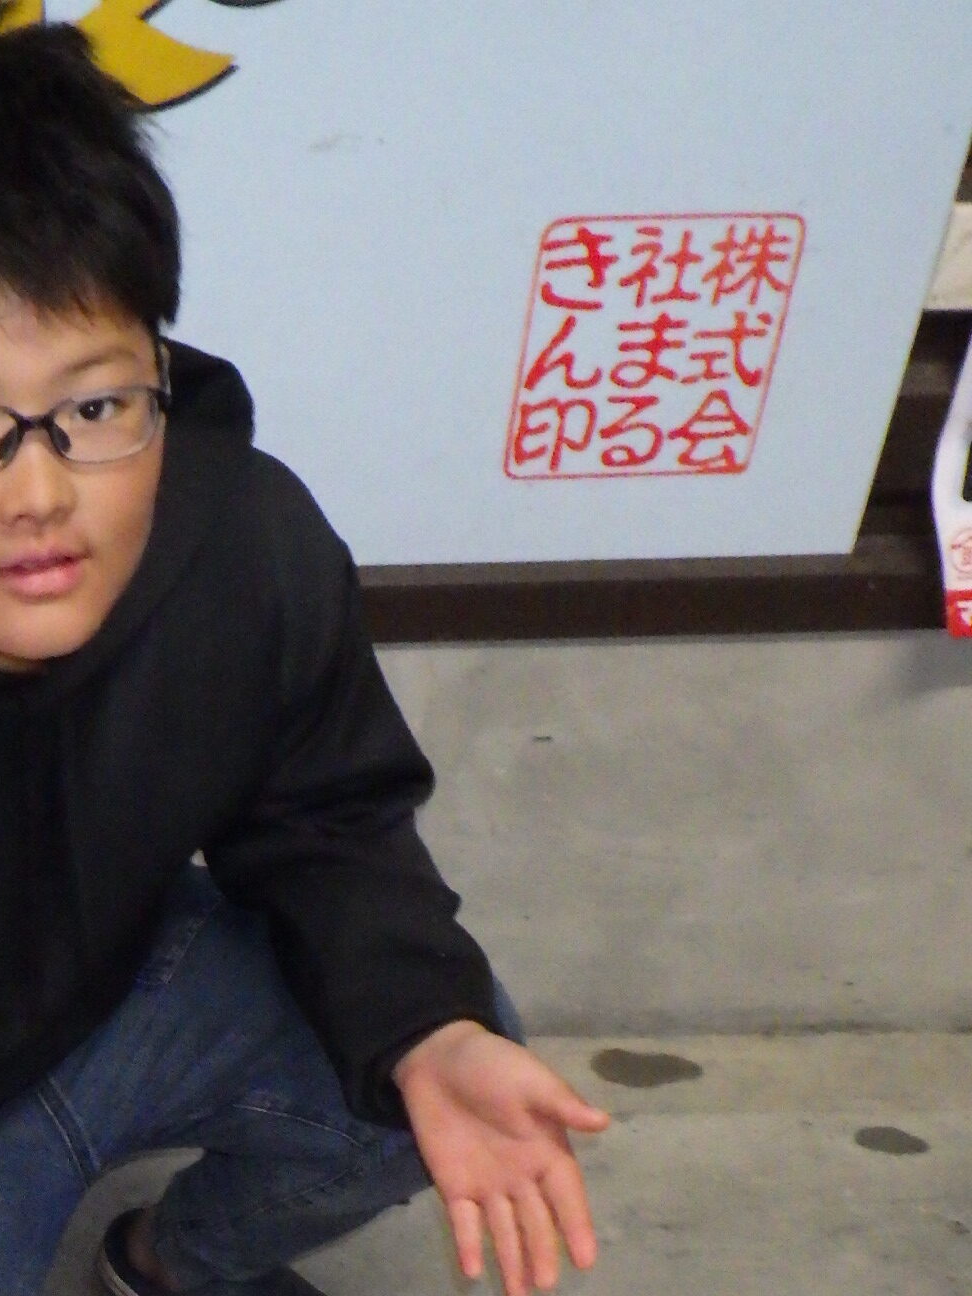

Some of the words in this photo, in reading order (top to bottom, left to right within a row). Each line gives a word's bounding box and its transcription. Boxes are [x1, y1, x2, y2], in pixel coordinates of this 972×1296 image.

[514, 226, 620, 472] きん印
[598, 226, 703, 467] 社まる
[667, 224, 792, 474] 株式会
